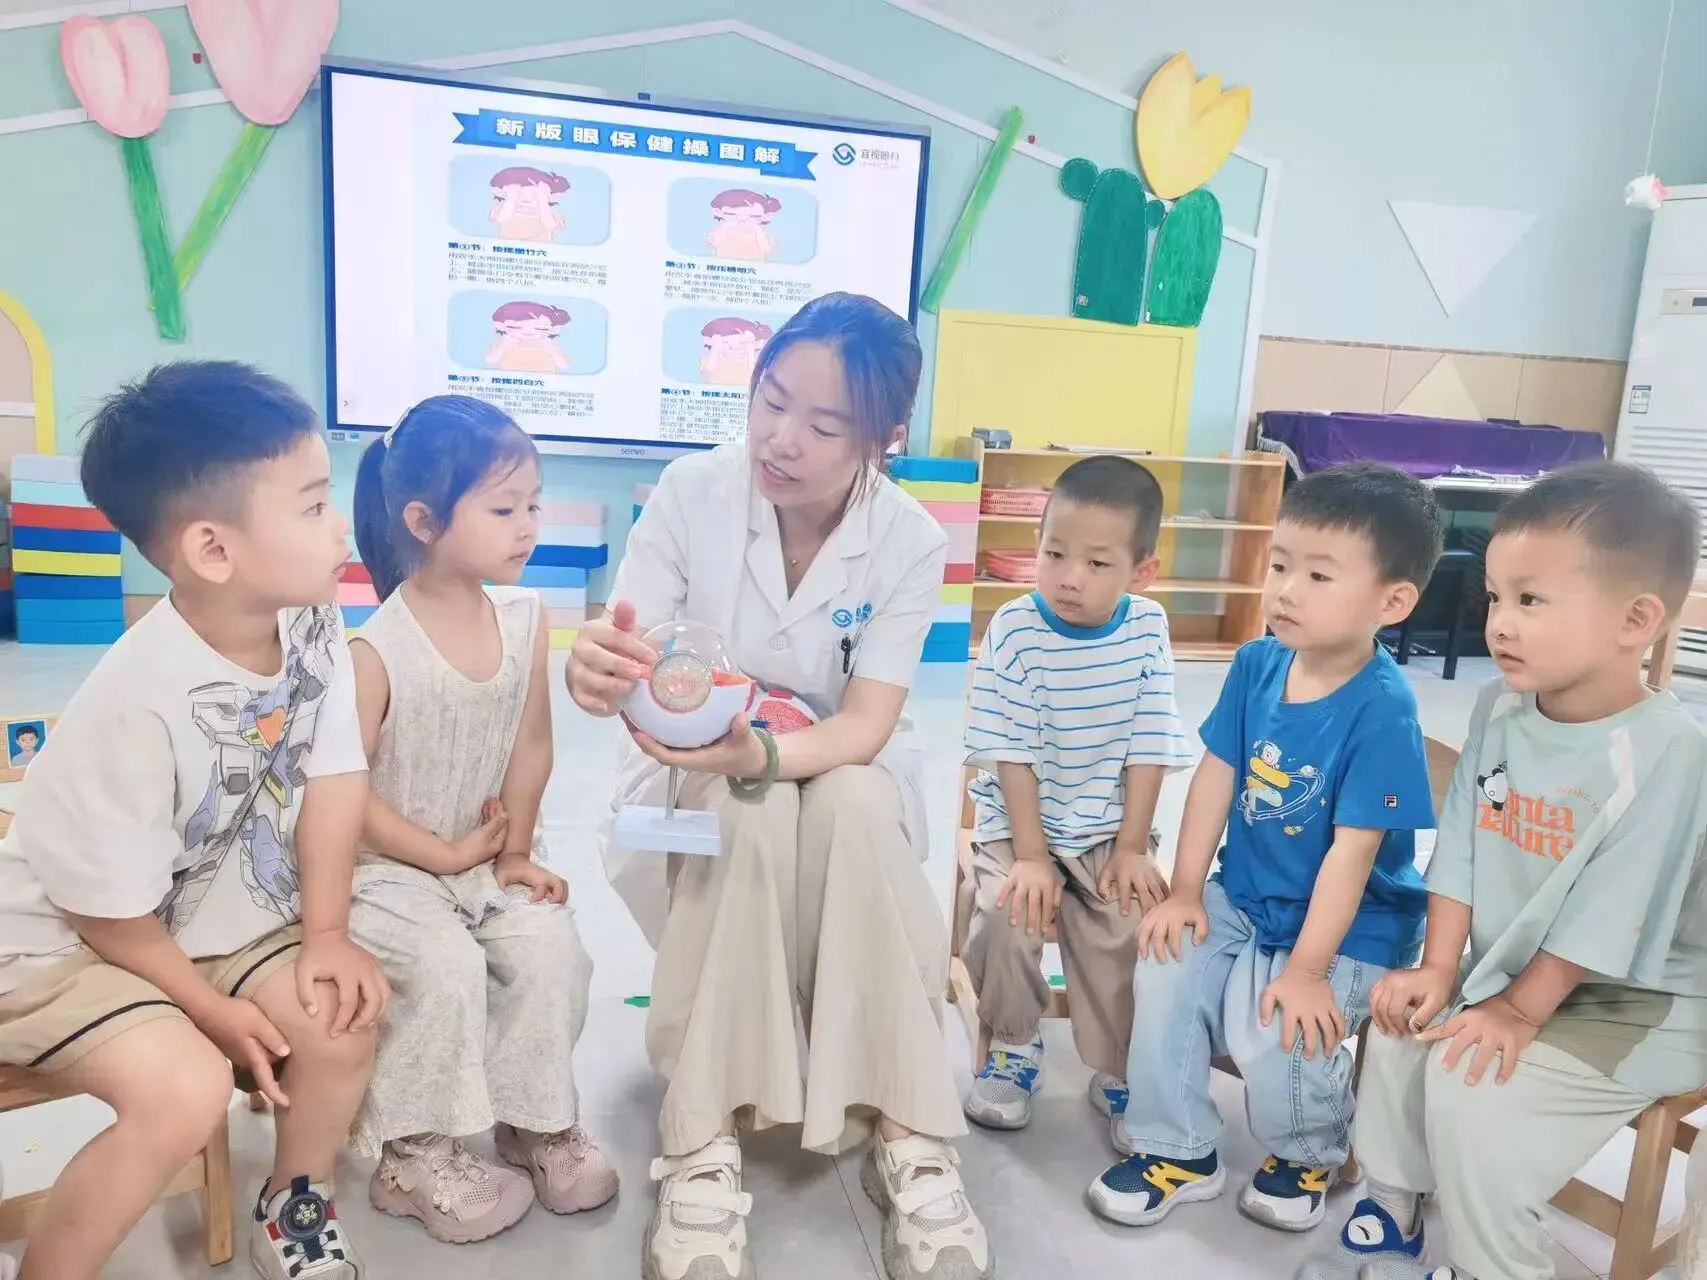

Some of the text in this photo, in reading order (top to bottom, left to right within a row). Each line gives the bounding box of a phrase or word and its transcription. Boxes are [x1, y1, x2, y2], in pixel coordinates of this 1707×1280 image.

[495, 117, 781, 165] 新版眼保健操图解
